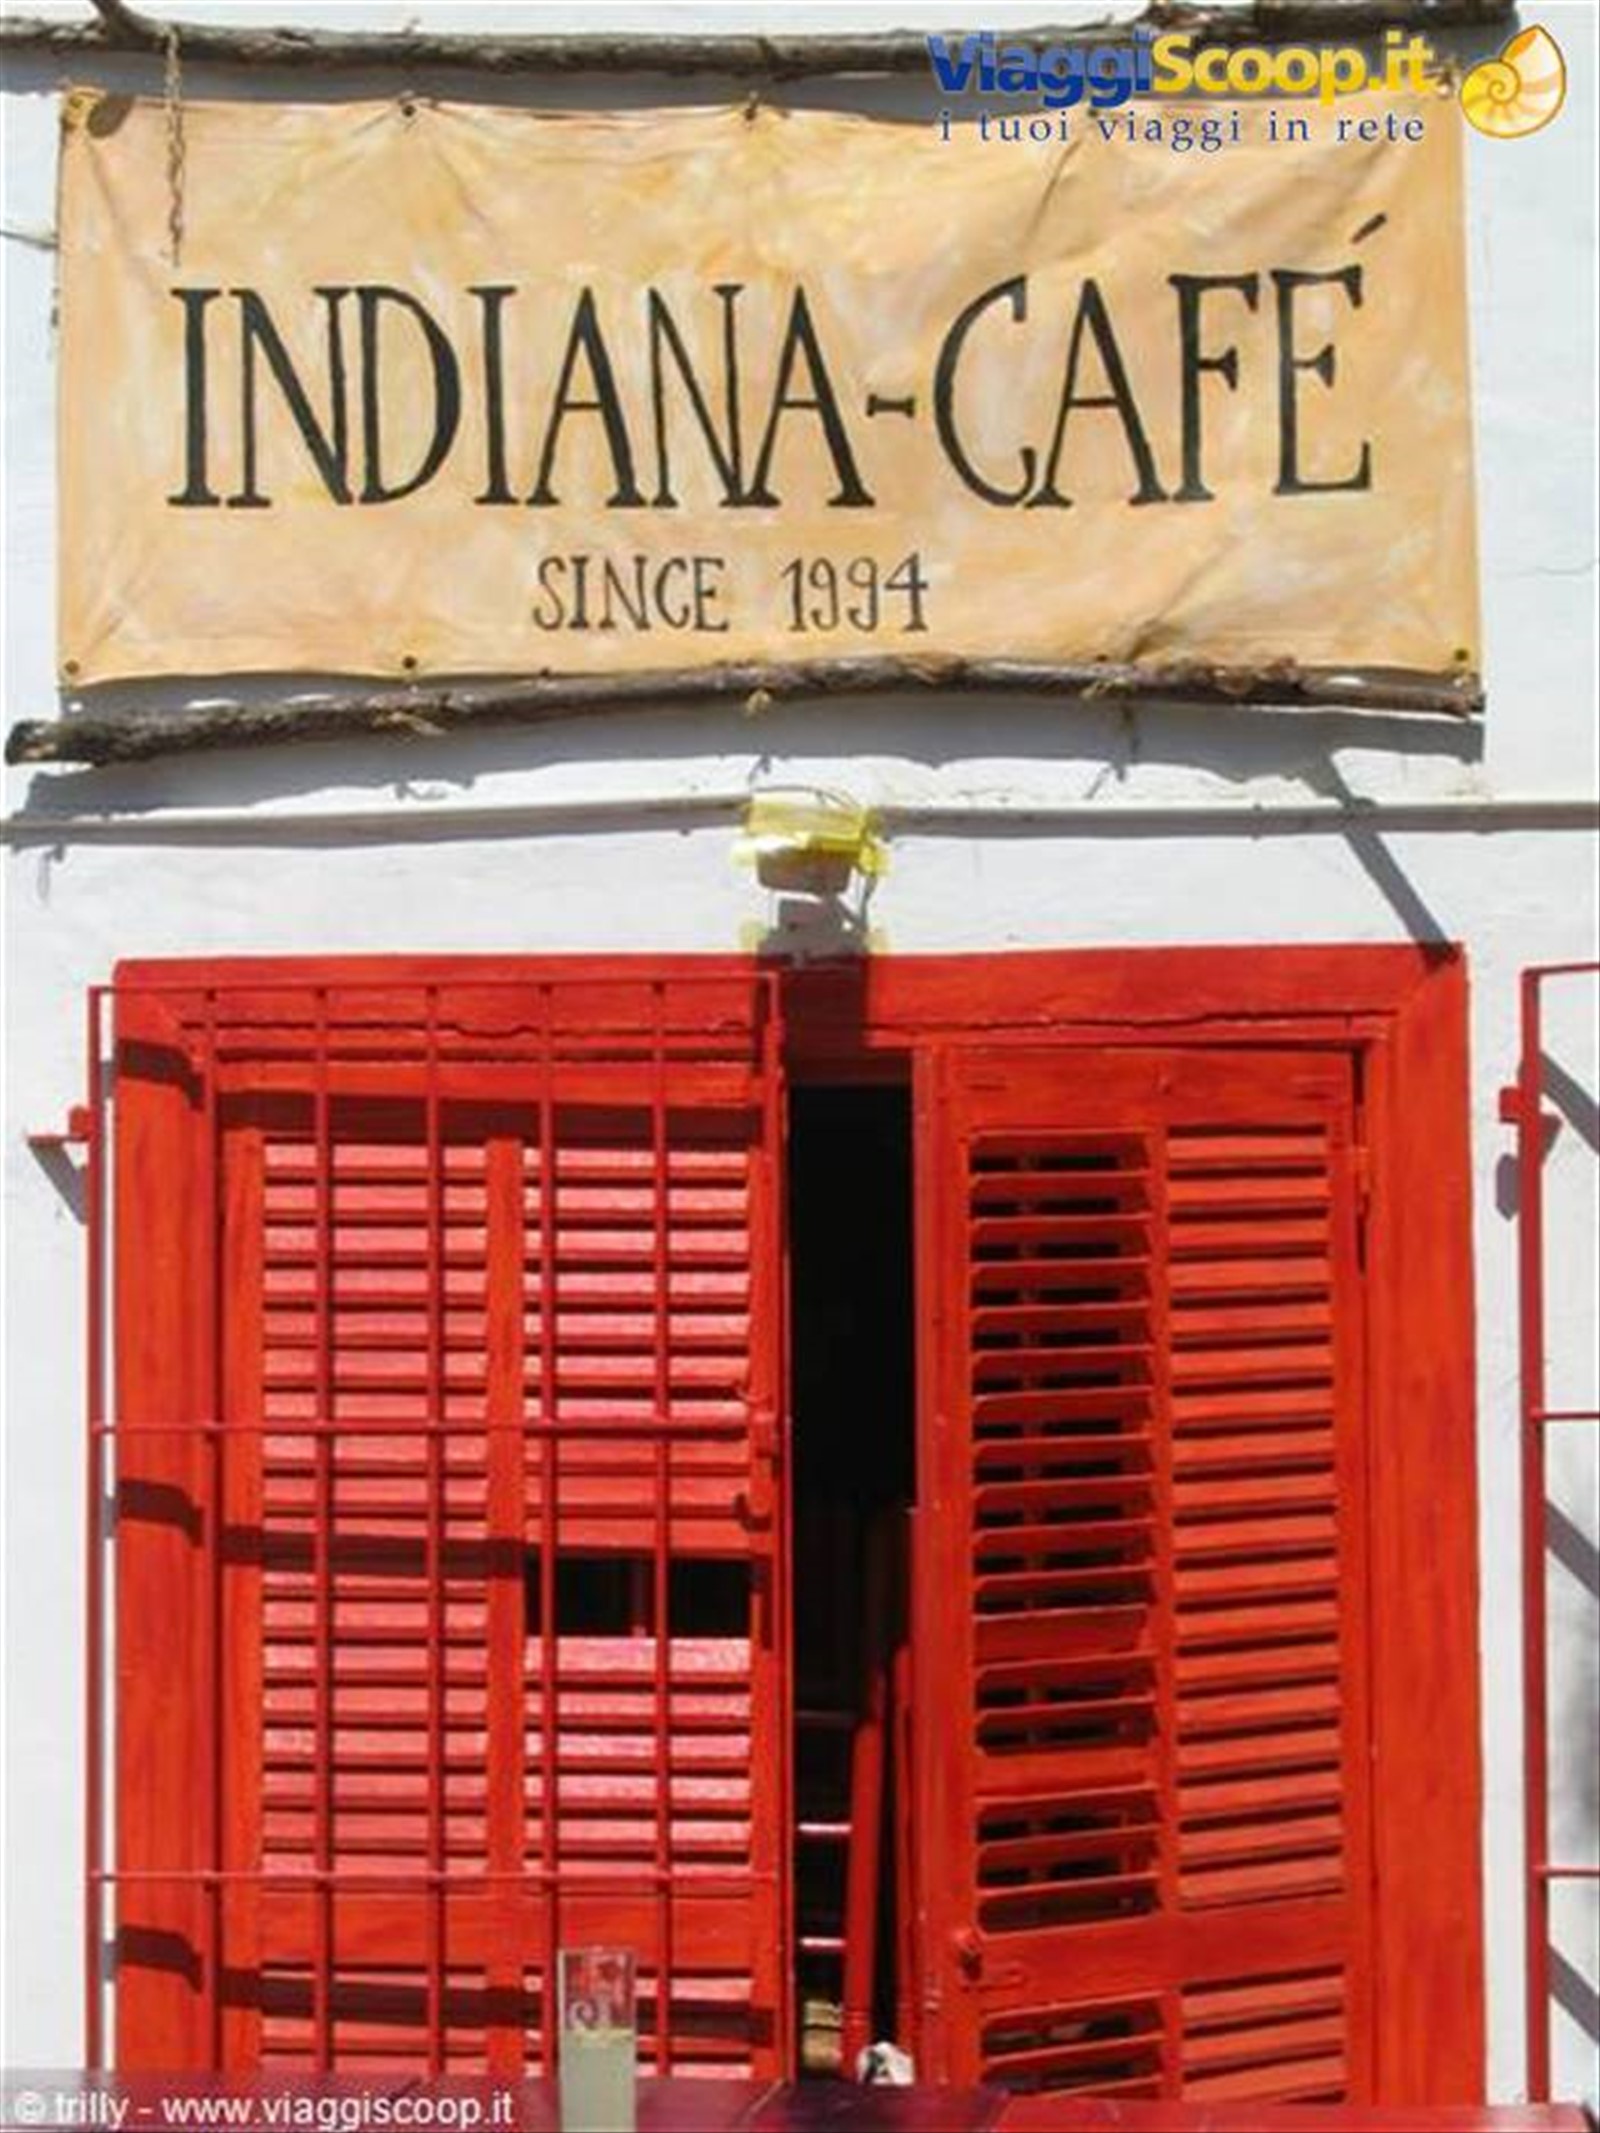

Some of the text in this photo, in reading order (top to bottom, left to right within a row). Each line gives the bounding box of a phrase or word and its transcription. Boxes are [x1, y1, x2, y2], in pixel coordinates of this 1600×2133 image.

[166, 212, 1387, 509] INDIANA-CAFÉ
[533, 552, 928, 632] SINCE 1994
